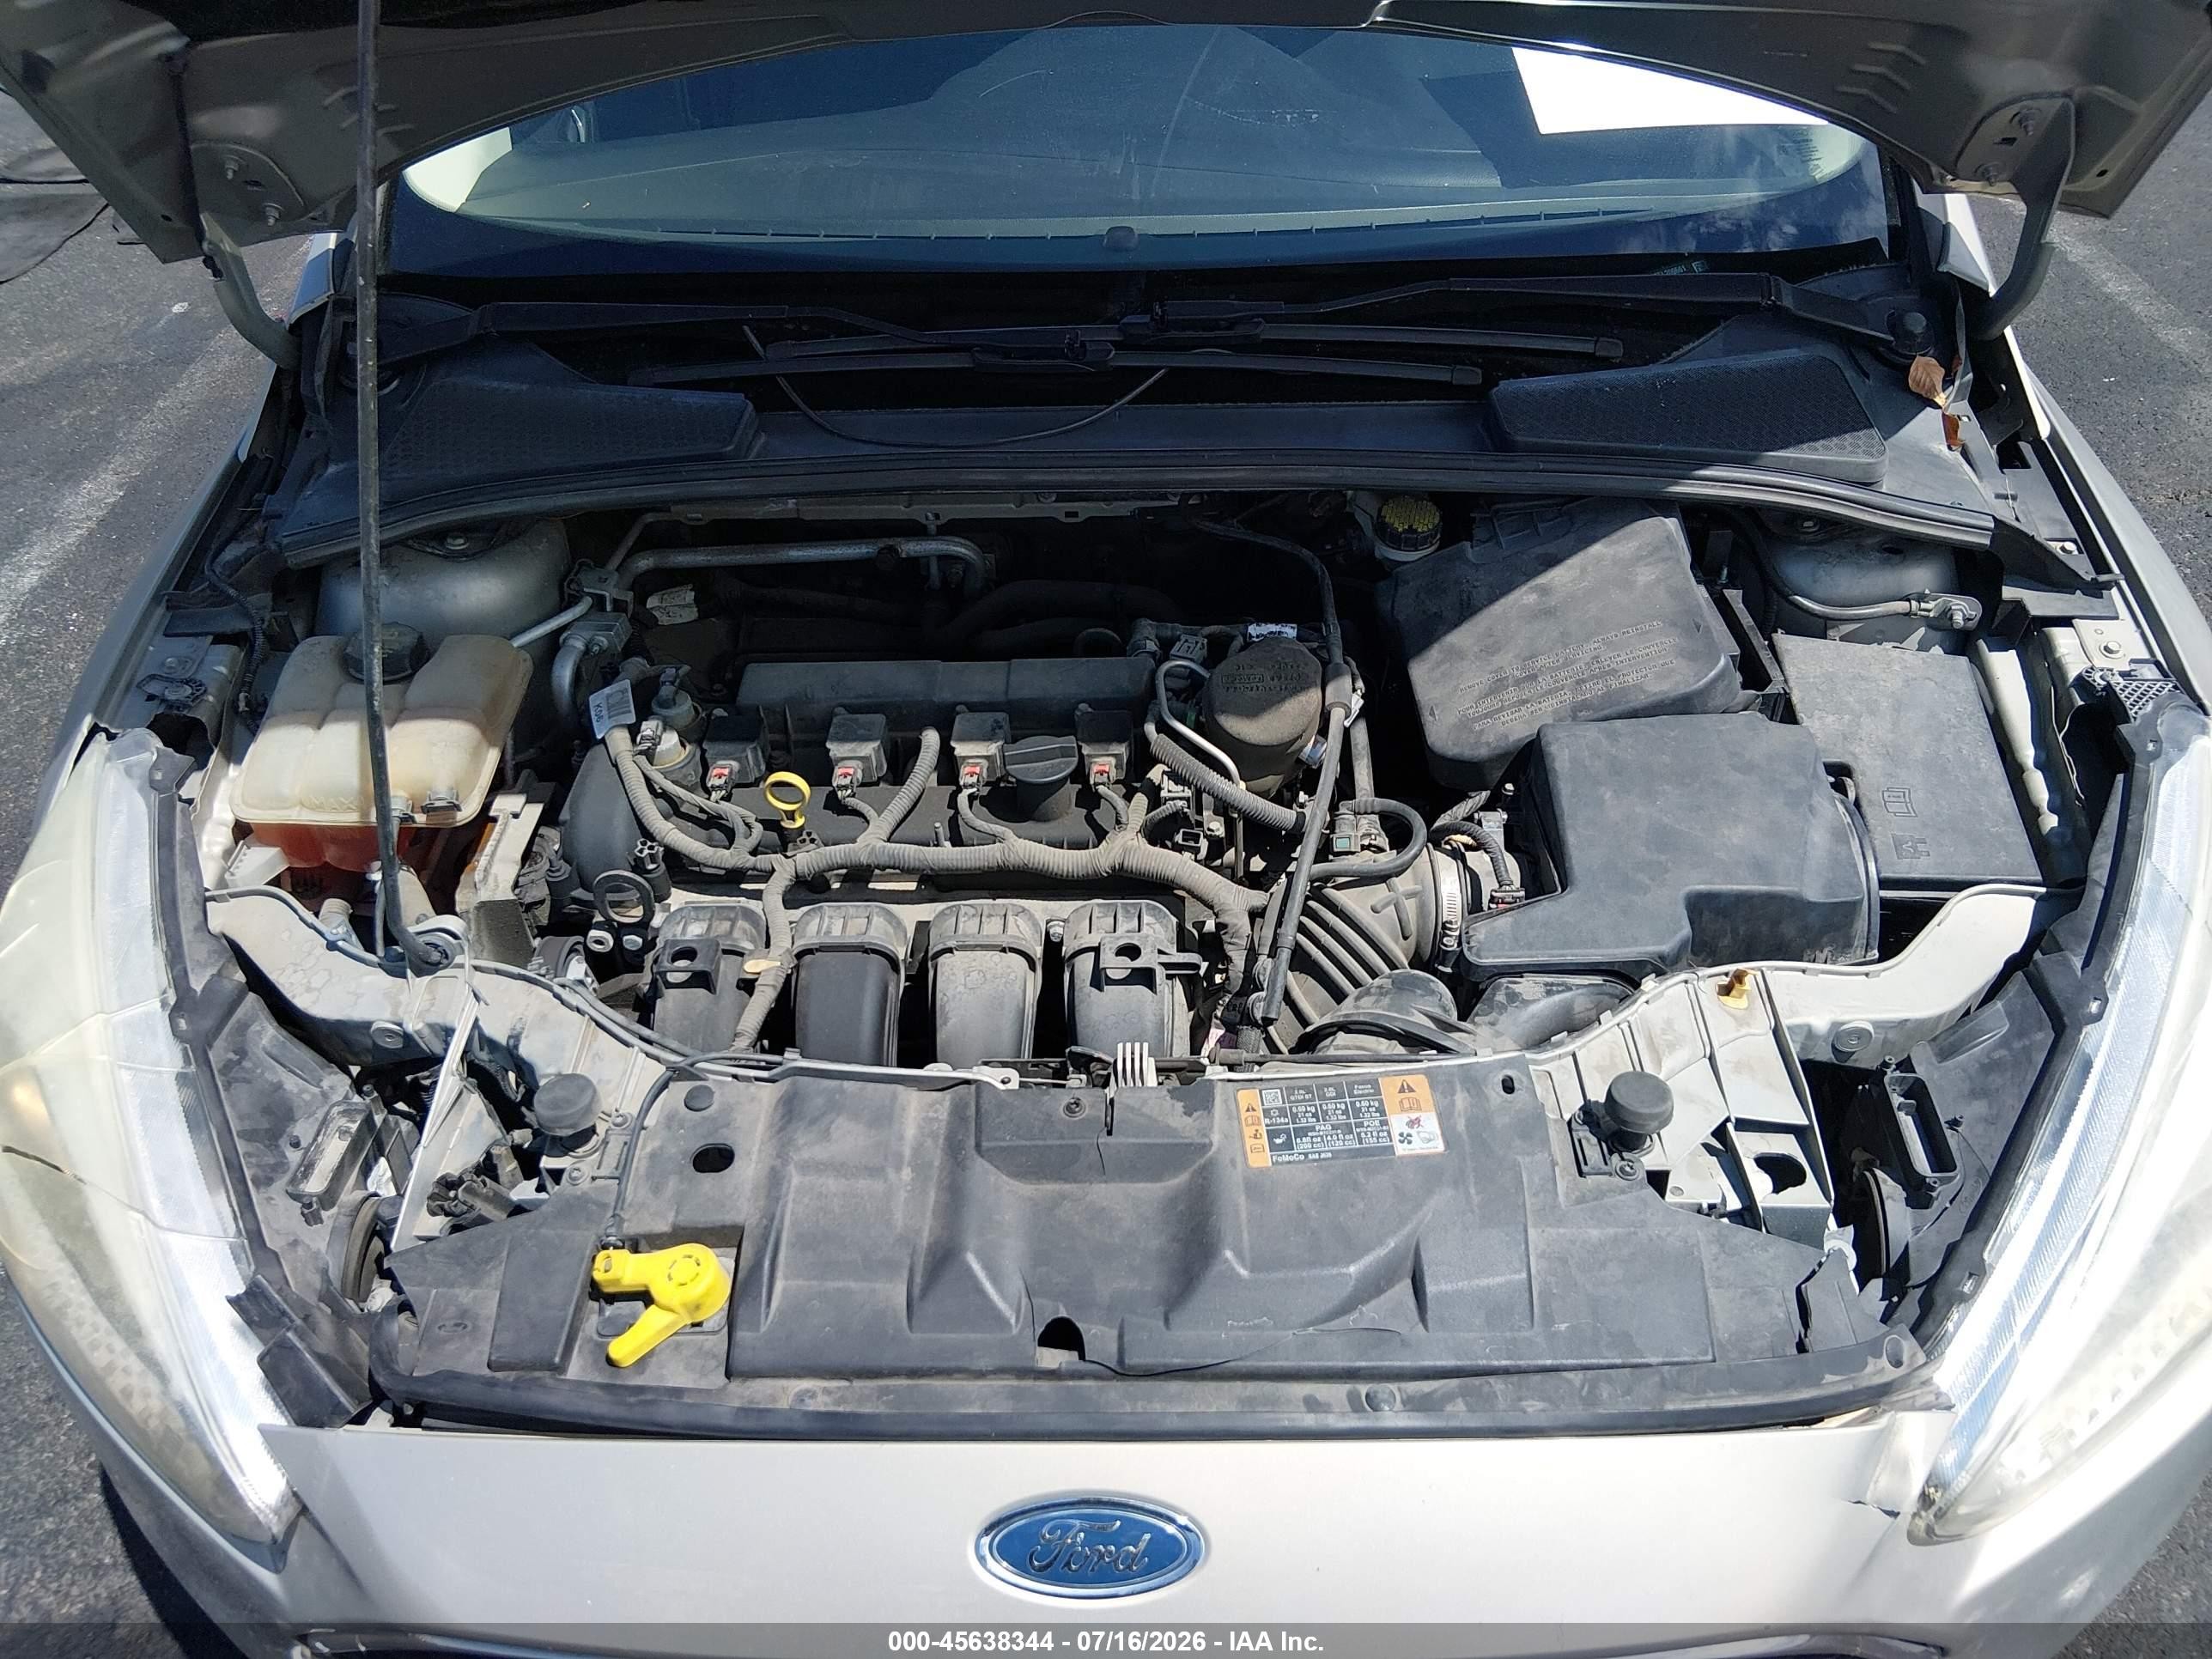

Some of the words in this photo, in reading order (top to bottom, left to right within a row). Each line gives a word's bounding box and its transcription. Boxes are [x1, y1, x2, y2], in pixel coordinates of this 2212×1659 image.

[1486, 670, 1509, 682] COVER
[1523, 655, 1551, 668] SERVICE
[1592, 634, 1619, 644] ALWAYS
[1621, 621, 1662, 635] REINSTALL
[1515, 667, 1536, 678] COVER
[1539, 659, 1560, 669] AFTER
[1457, 704, 1474, 714] POUR
[1477, 687, 1518, 706] INTERVENIR
[1591, 653, 1621, 665] ENLEVER
[1547, 672, 1585, 687] COUVERCLE
[1617, 665, 1657, 678] PROTECTOR
[1030, 1519, 1150, 1574] Ford
